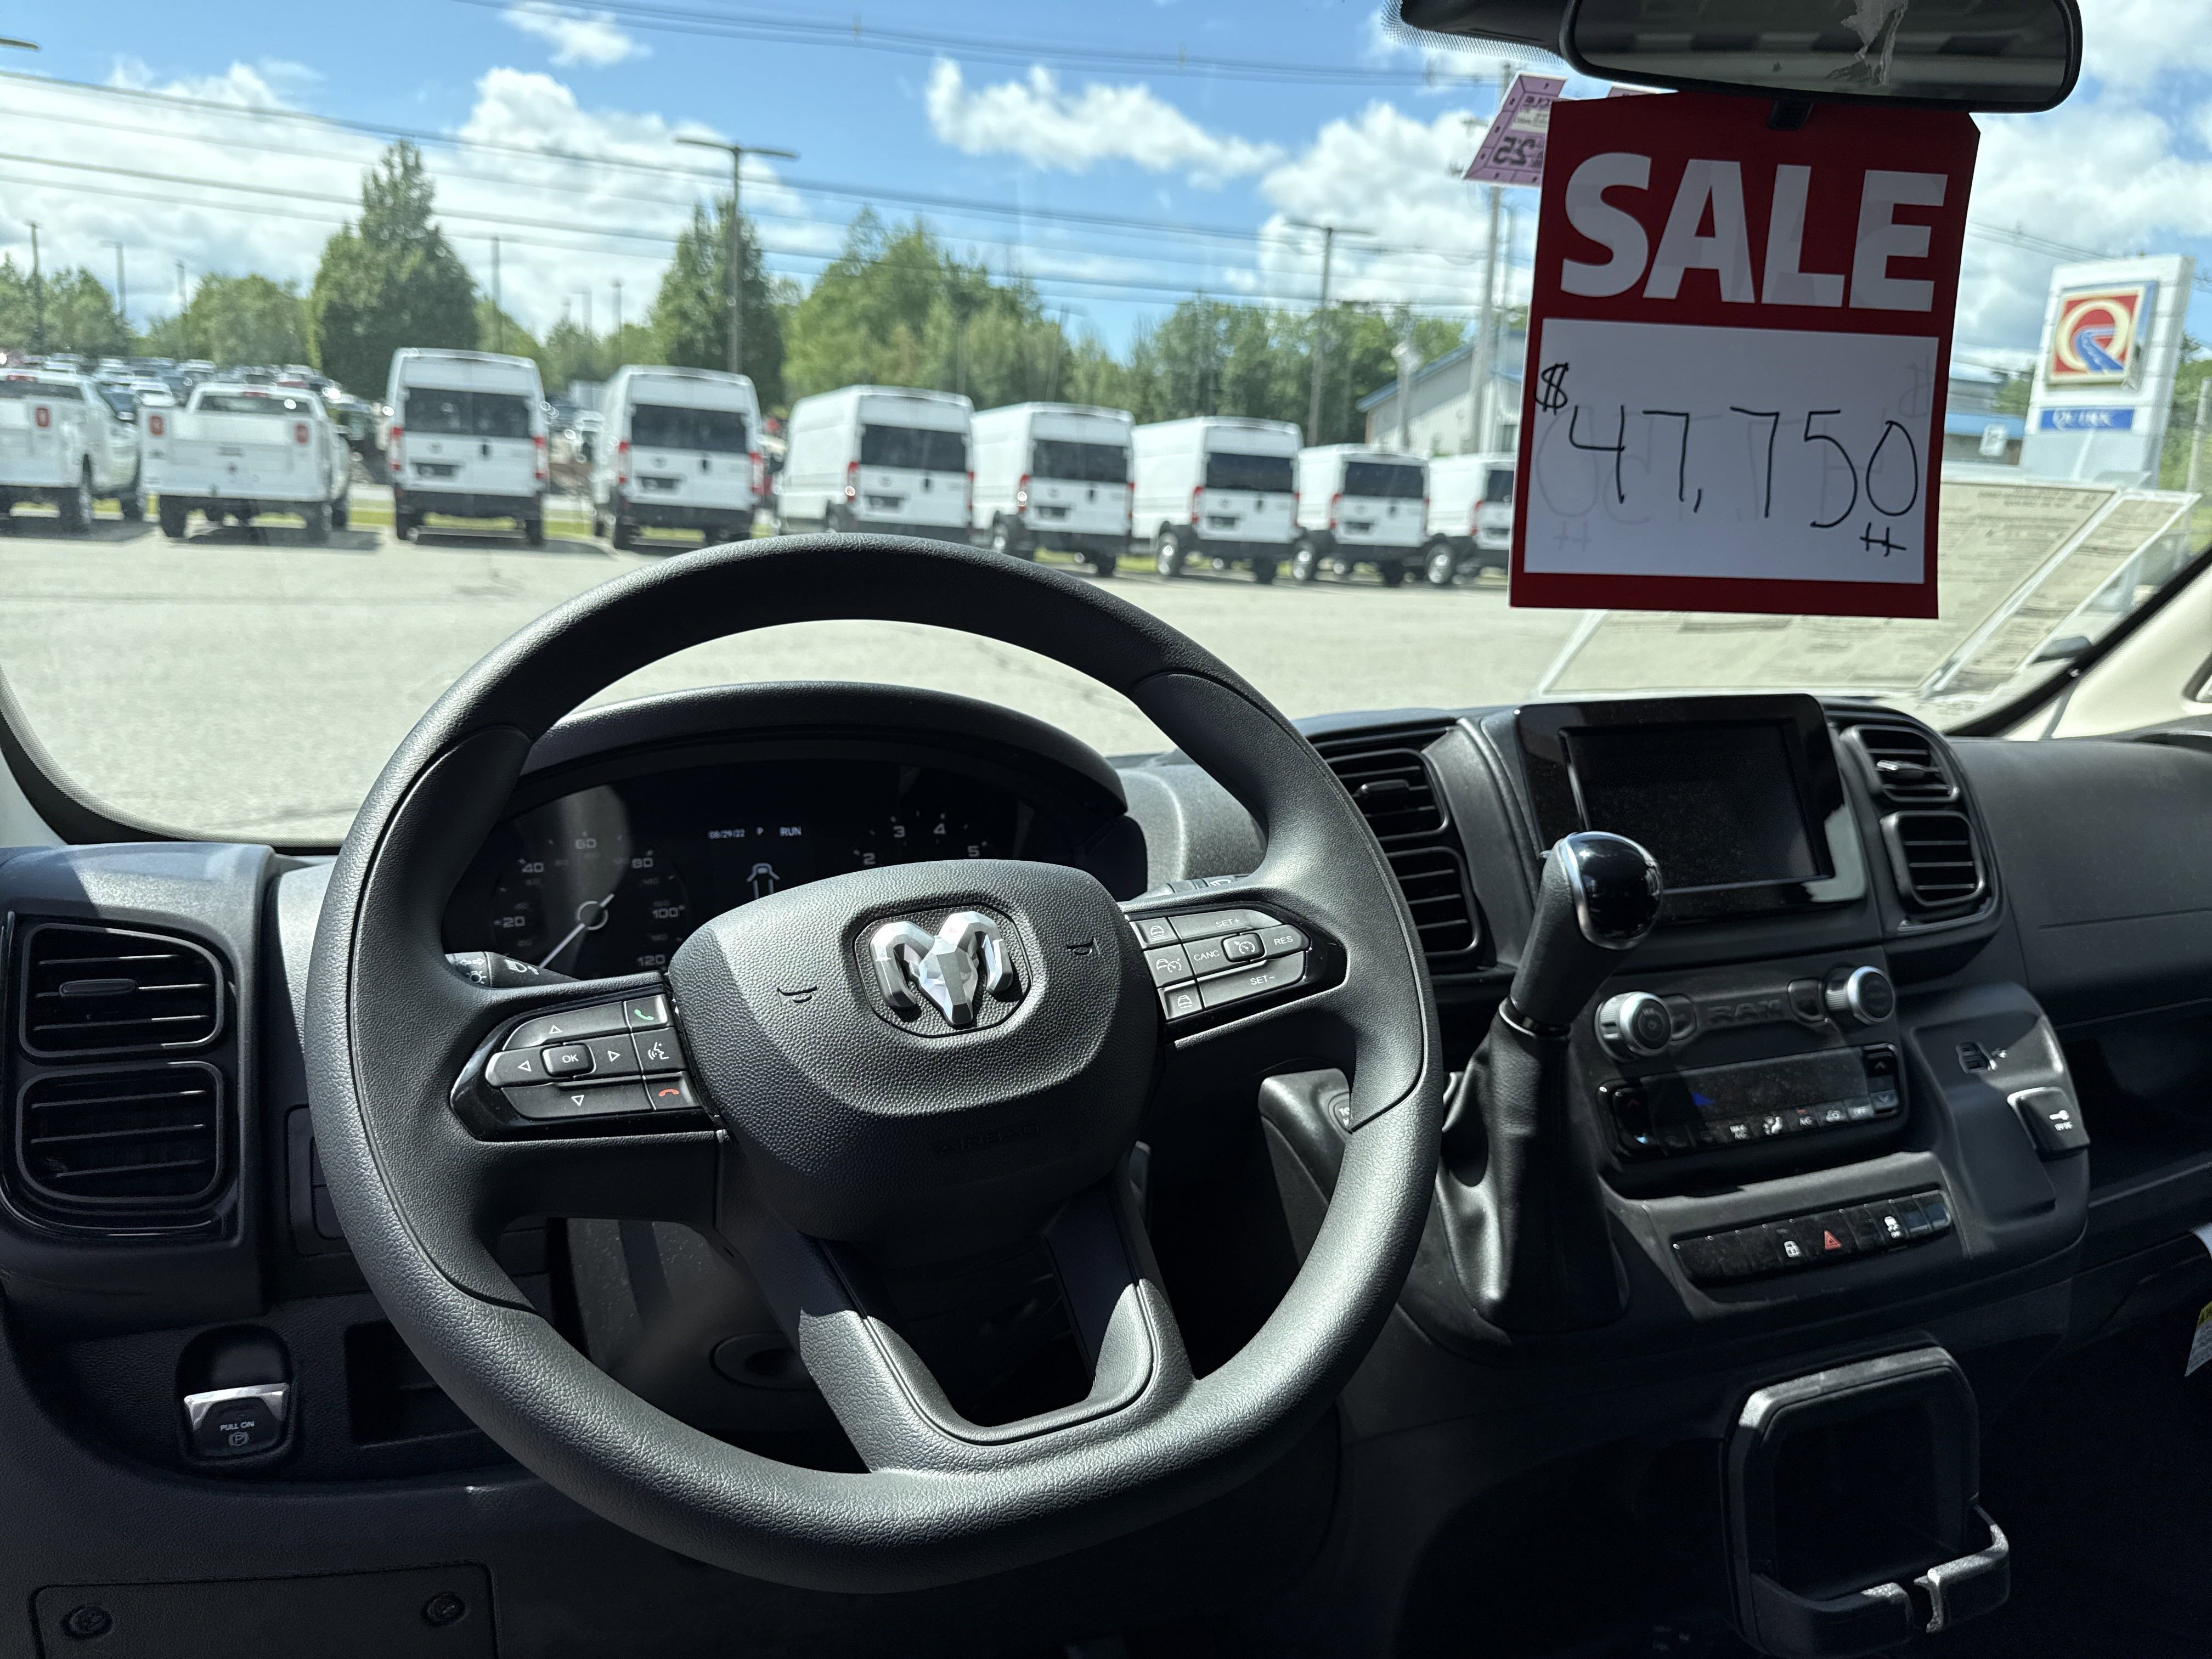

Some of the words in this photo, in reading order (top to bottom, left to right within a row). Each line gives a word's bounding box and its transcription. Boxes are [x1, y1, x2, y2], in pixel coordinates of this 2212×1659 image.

[1560, 151, 1948, 312] SALE
[756, 827, 764, 836] P
[779, 826, 802, 837] RUN
[894, 826, 905, 838] 3
[933, 823, 946, 834] 4
[575, 838, 597, 849] 60
[967, 845, 980, 857] 5
[631, 857, 653, 868] 80
[863, 853, 876, 865] 2
[522, 862, 544, 873] 40
[652, 907, 679, 919] 100
[503, 916, 526, 928] 20
[1215, 917, 1240, 928] SET+
[1273, 935, 1293, 946] RES
[637, 954, 665, 966] 120
[1194, 950, 1220, 962] CANC
[562, 1053, 579, 1064] OK
[220, 1423, 240, 1431] PULL
